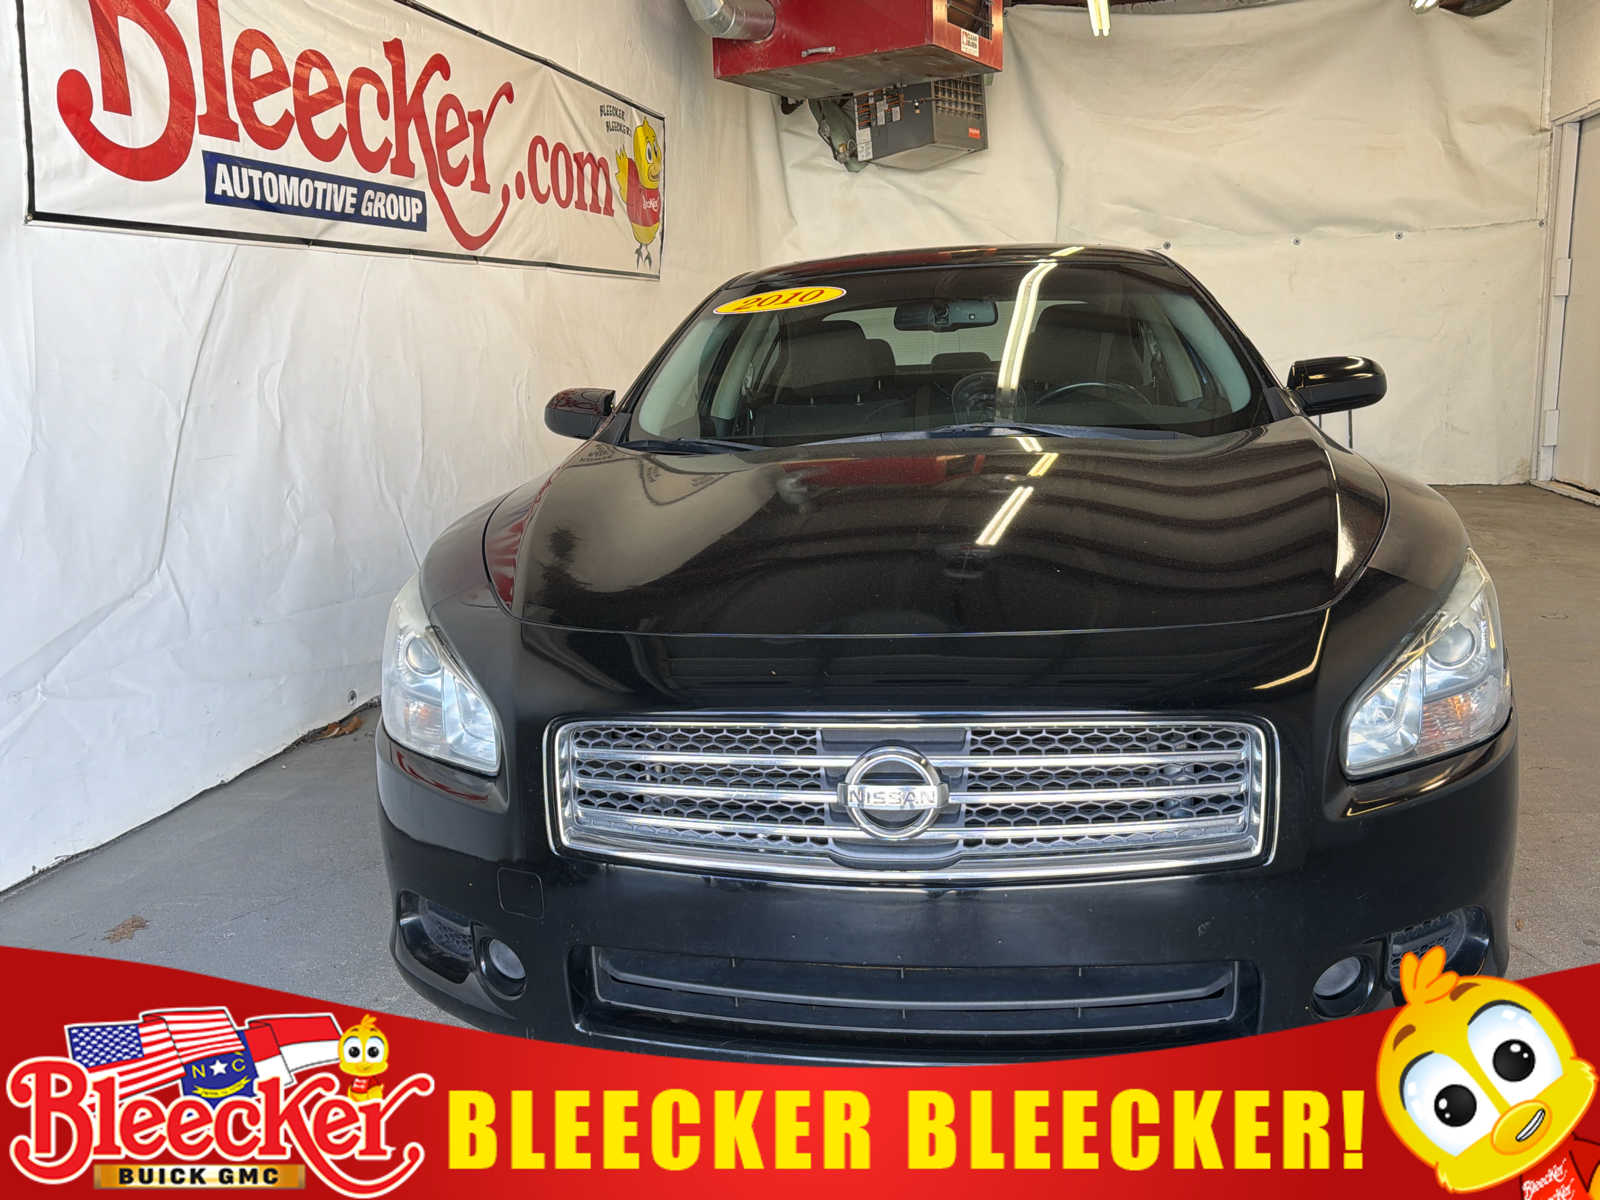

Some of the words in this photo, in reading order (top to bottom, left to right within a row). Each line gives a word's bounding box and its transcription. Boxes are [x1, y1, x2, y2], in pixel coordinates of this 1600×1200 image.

[214, 163, 358, 214] AUTOMOTIVE
[361, 189, 423, 223] GROUP
[734, 289, 825, 311] 2010
[848, 788, 936, 806] NISSAN
